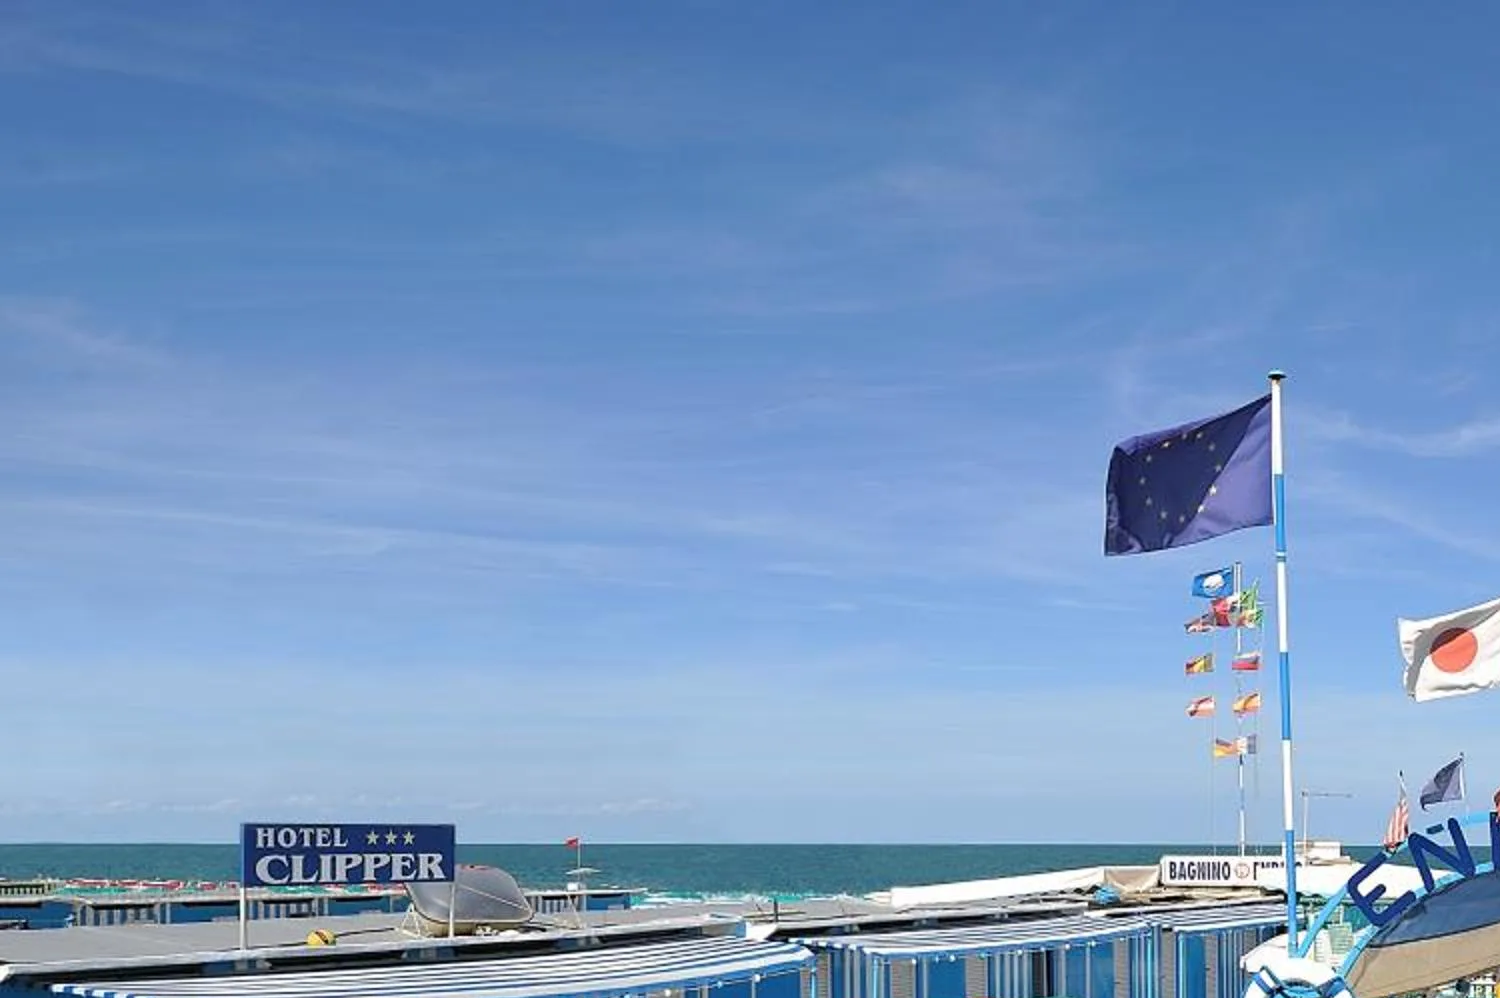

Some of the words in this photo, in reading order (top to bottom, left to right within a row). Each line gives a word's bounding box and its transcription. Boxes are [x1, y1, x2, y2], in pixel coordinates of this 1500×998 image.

[256, 827, 349, 849] HOTEL
[255, 853, 447, 885] CLIPPER
[1169, 860, 1231, 881] BAGNINO
